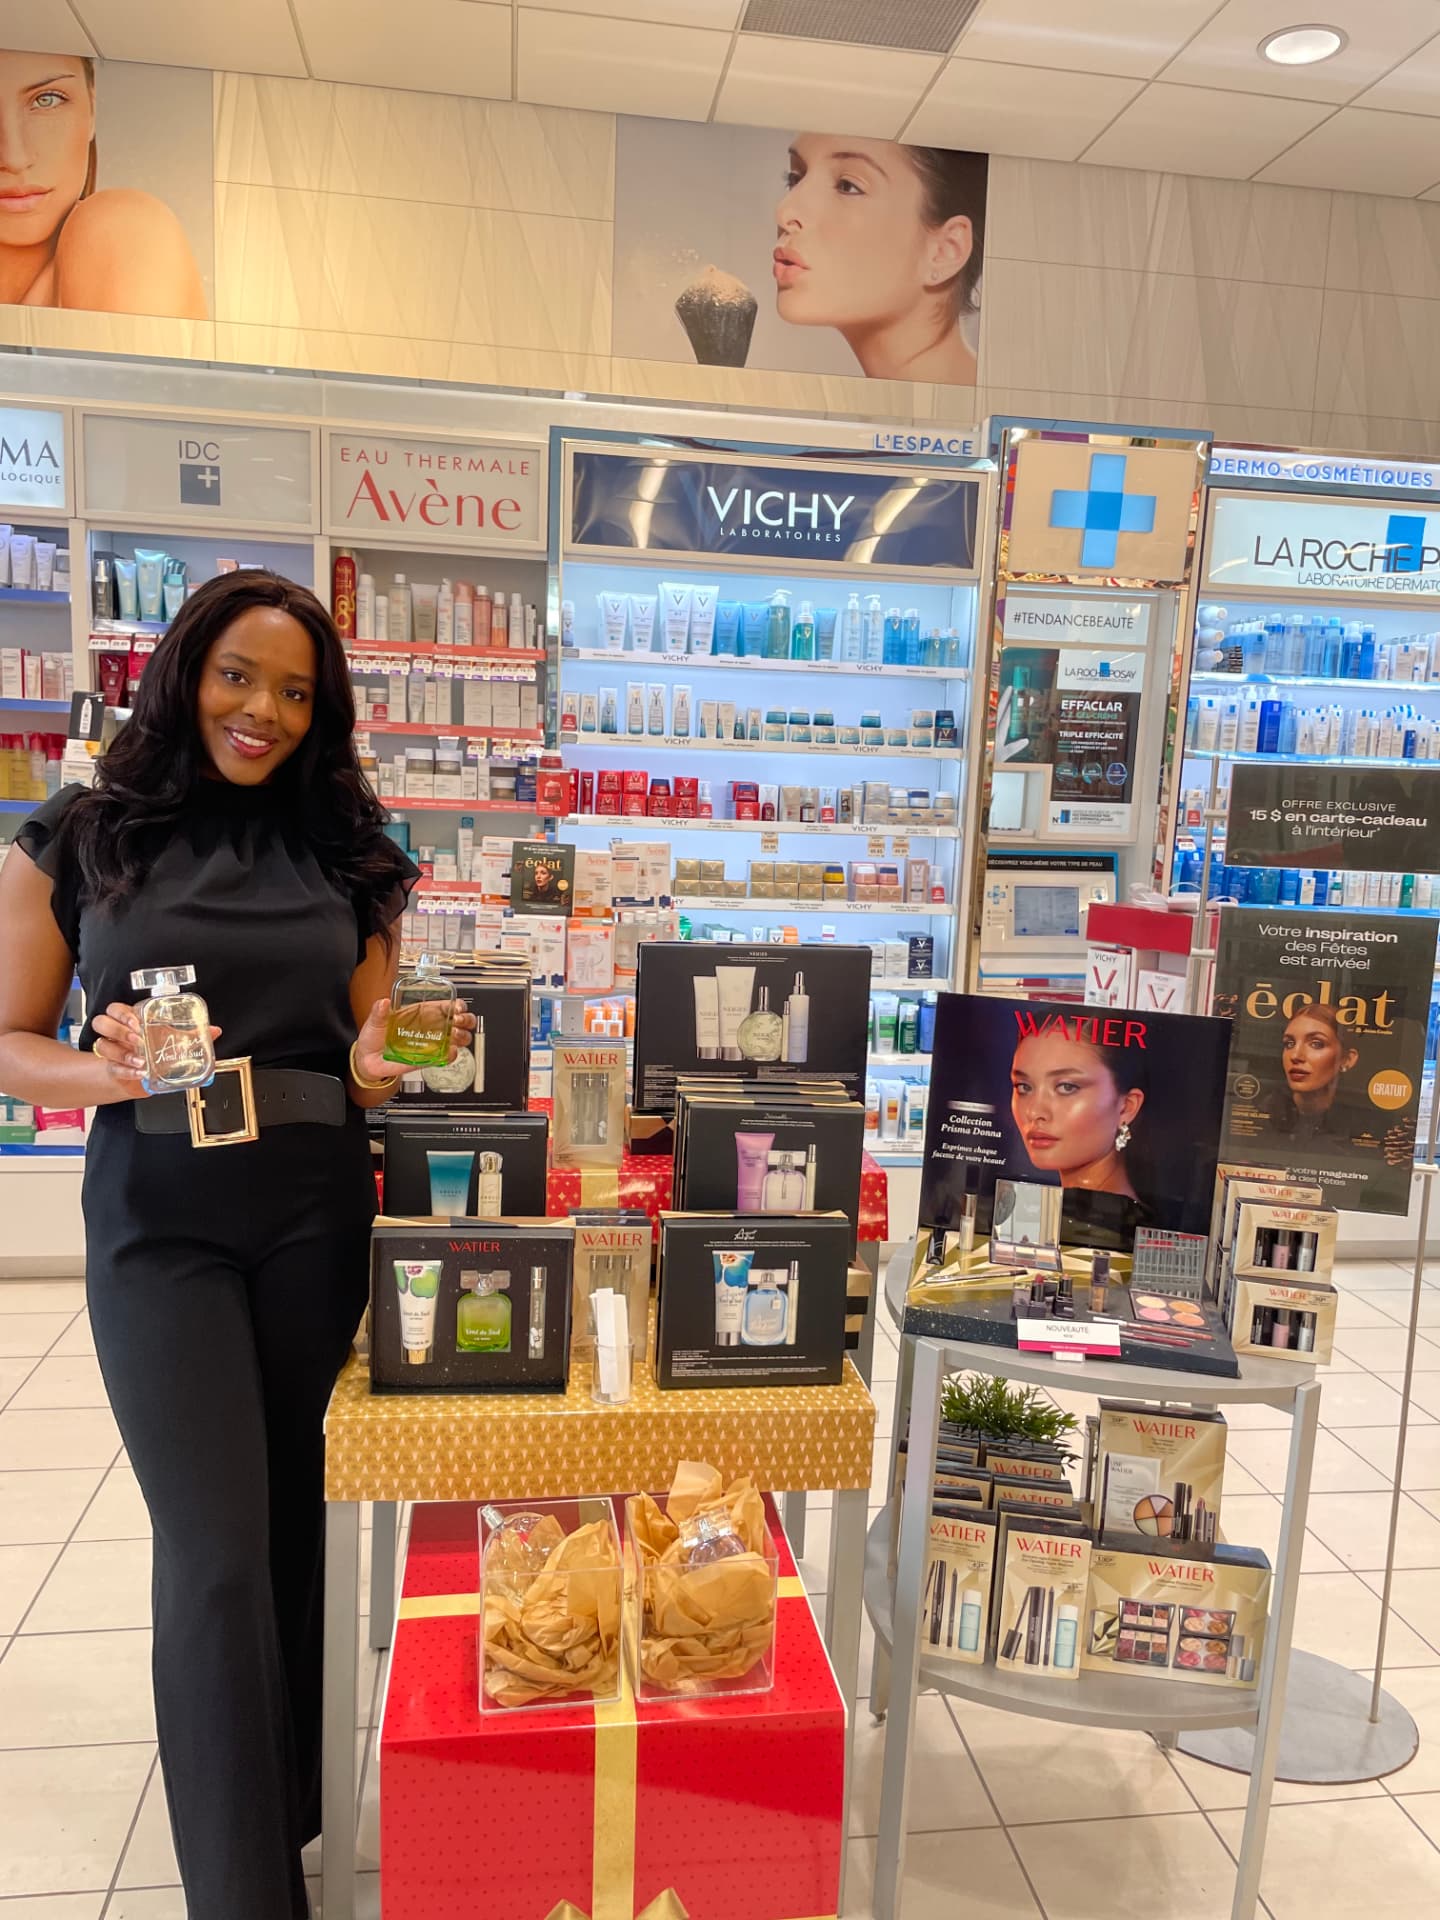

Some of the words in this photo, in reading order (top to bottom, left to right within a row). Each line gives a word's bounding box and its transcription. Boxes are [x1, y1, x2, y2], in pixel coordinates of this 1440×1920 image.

[178, 440, 221, 461] IDC
[873, 433, 974, 455] L'ESPACE
[341, 448, 388, 465] EAU
[404, 452, 530, 476] THERMALE
[346, 468, 522, 530] Avène
[707, 486, 855, 530] VICHY
[720, 527, 842, 543] LABORATOIRES
[1254, 535, 1294, 567] LA
[1300, 538, 1414, 574] ROCHE
[1420, 546, 1440, 575] P
[1298, 572, 1387, 590] LABORATOIRE
[1013, 611, 1135, 629] #TENDANCEBEAUTE
[662, 654, 690, 663] VICHY
[856, 664, 883, 672] VICHY
[1061, 700, 1123, 712] EFFACLAR
[664, 737, 691, 745] VICHY
[1059, 731, 1084, 739] TRIPLE
[1282, 799, 1322, 809] OFFRE
[1326, 801, 1396, 813] EXCLUSIVE
[661, 818, 689, 827] VICHY
[1250, 809, 1267, 821] 15
[1270, 808, 1281, 823] $
[1285, 812, 1306, 823] en
[1309, 812, 1427, 827] carte-cadeau
[852, 825, 878, 833] VICHY
[1291, 825, 1302, 836] à
[846, 903, 872, 911] VICHY
[1259, 924, 1301, 938] Votre
[1305, 926, 1398, 944] inspiration
[1285, 939, 1317, 952] des
[1320, 941, 1368, 956] Fêtes
[1095, 953, 1117, 963] VICHY
[1279, 954, 1306, 966] est
[1310, 954, 1371, 970] arrivée!
[397, 1027, 414, 1037] Vent
[414, 1031, 424, 1039] du
[425, 1031, 443, 1040] Sud
[1013, 1010, 1148, 1050] WATIER
[563, 1052, 618, 1065] WATIER
[1373, 1082, 1408, 1097] GRATUIT
[949, 1114, 992, 1127] Collection
[941, 1123, 971, 1135] Prisma
[972, 1127, 1002, 1138] Donna
[1298, 1174, 1317, 1183] des
[1318, 1176, 1346, 1186] Fêtes
[1319, 1169, 1369, 1181] magazine
[1258, 1185, 1293, 1198] WATIER
[1272, 1209, 1309, 1222] WATIER
[449, 1241, 500, 1253] WATIER
[582, 1232, 643, 1247] WATIER
[1268, 1287, 1307, 1301] WATIER
[1133, 1418, 1196, 1440] WATIER
[993, 1461, 1054, 1479] WATIER
[1016, 1536, 1082, 1559] WATIER
[1147, 1561, 1215, 1583] WATIER
